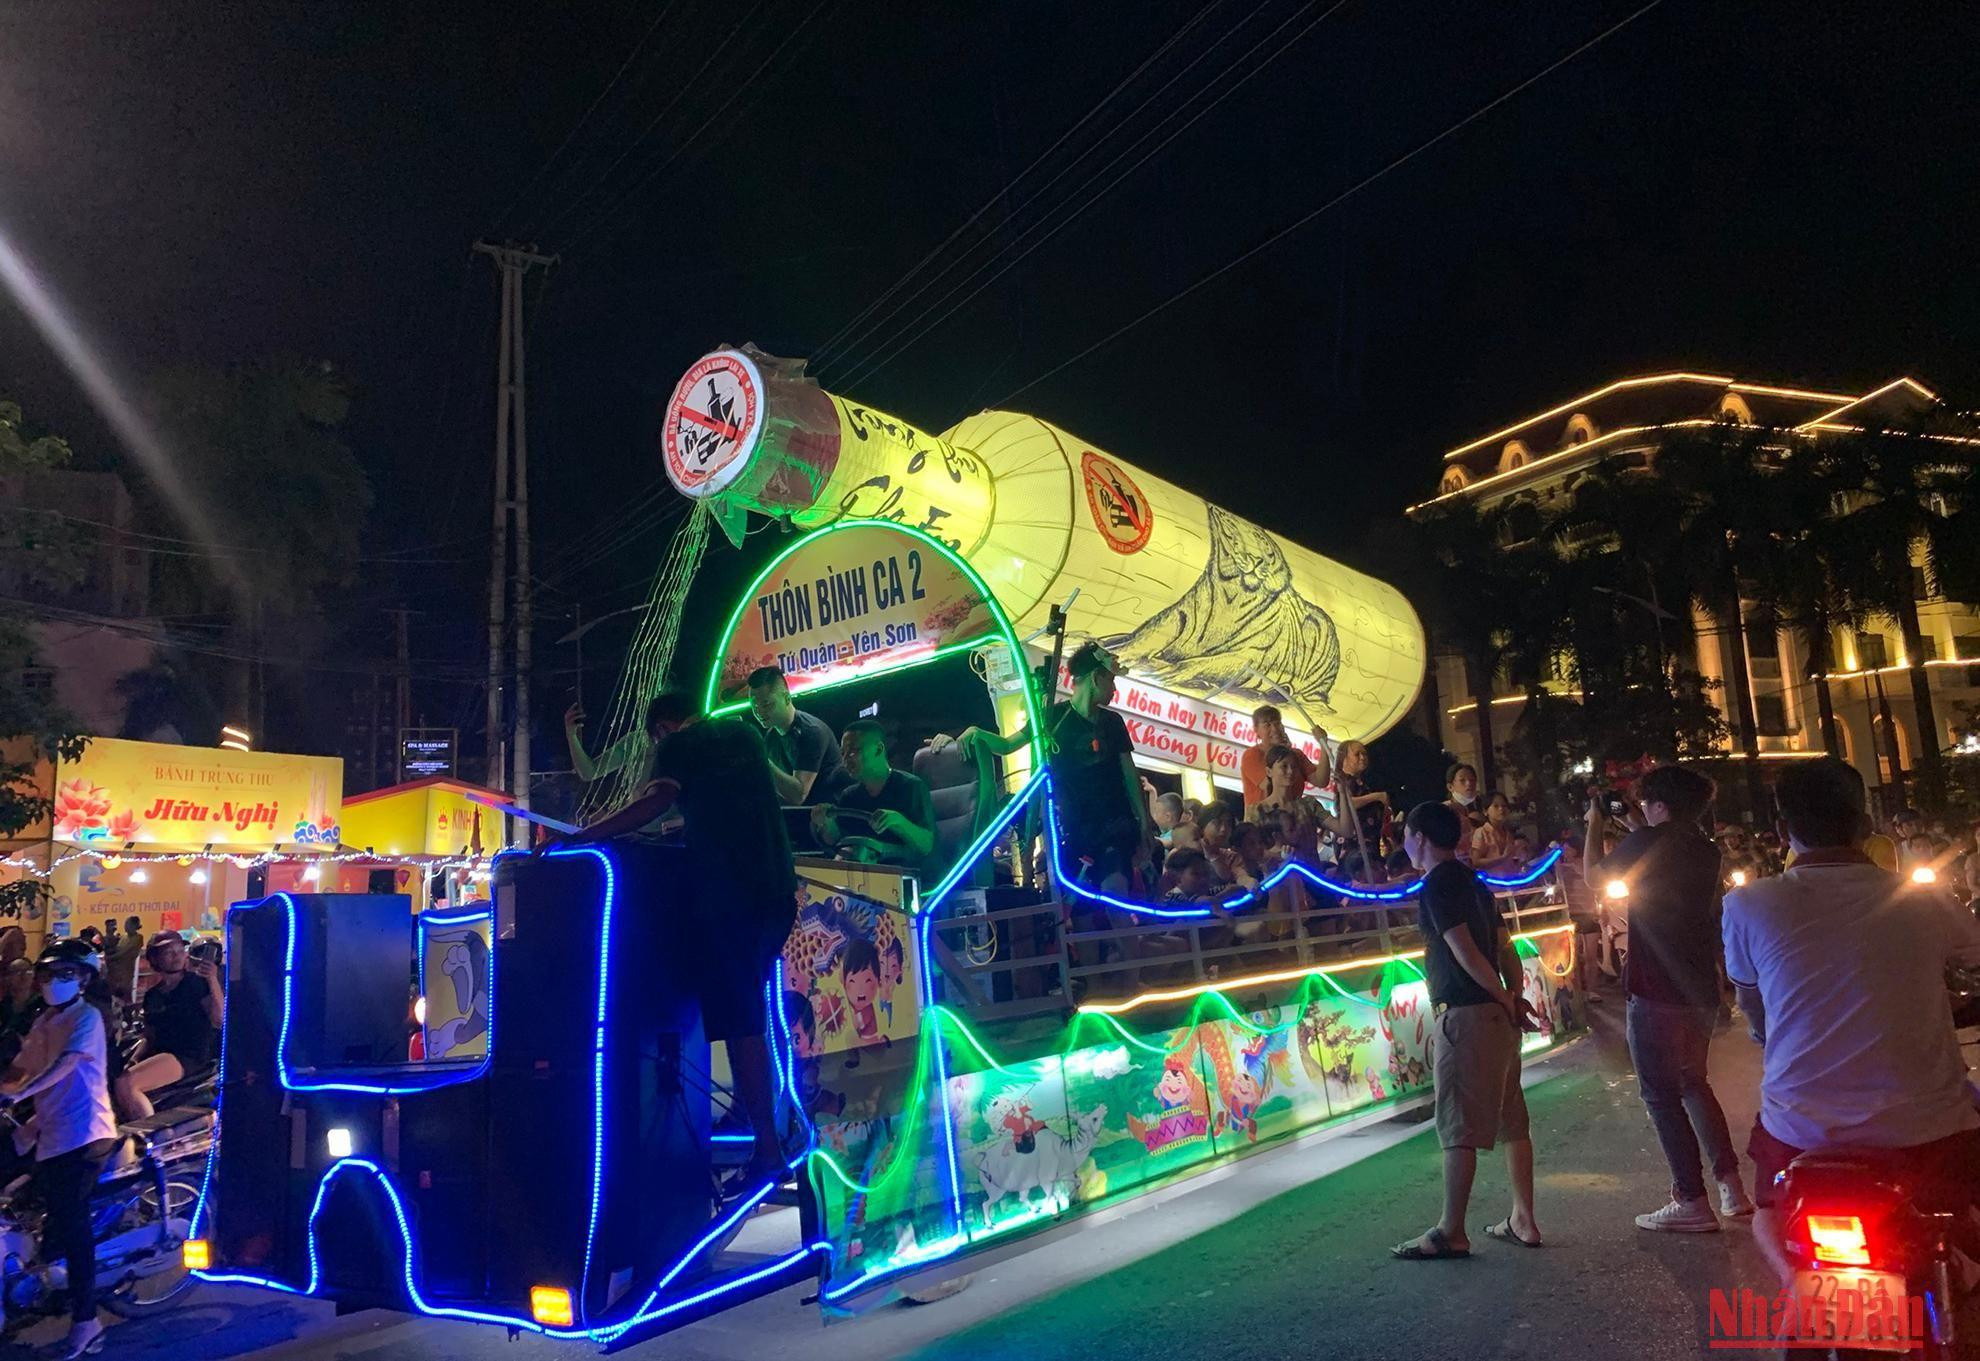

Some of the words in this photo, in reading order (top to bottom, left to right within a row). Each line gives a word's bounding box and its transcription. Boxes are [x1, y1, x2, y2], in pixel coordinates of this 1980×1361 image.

[758, 579, 813, 643] THÔN
[816, 566, 869, 626] BÌNH
[873, 556, 906, 610] CA
[908, 550, 926, 600] 2
[778, 651, 796, 673] Tứ
[800, 643, 837, 671] Quận
[851, 631, 880, 655] Yên
[885, 622, 917, 646] Sơn
[1126, 688, 1161, 716] Hôm
[1168, 701, 1197, 730] Nay
[1202, 711, 1228, 736] Thế
[1126, 719, 1199, 765] Không
[1206, 742, 1238, 769] Với
[154, 763, 194, 782] BÁNH
[200, 769, 245, 785] TRUNG
[144, 799, 209, 822] Hữu
[213, 801, 278, 831] Nghị
[90, 899, 109, 914] KẾT
[111, 902, 136, 913] GIAO
